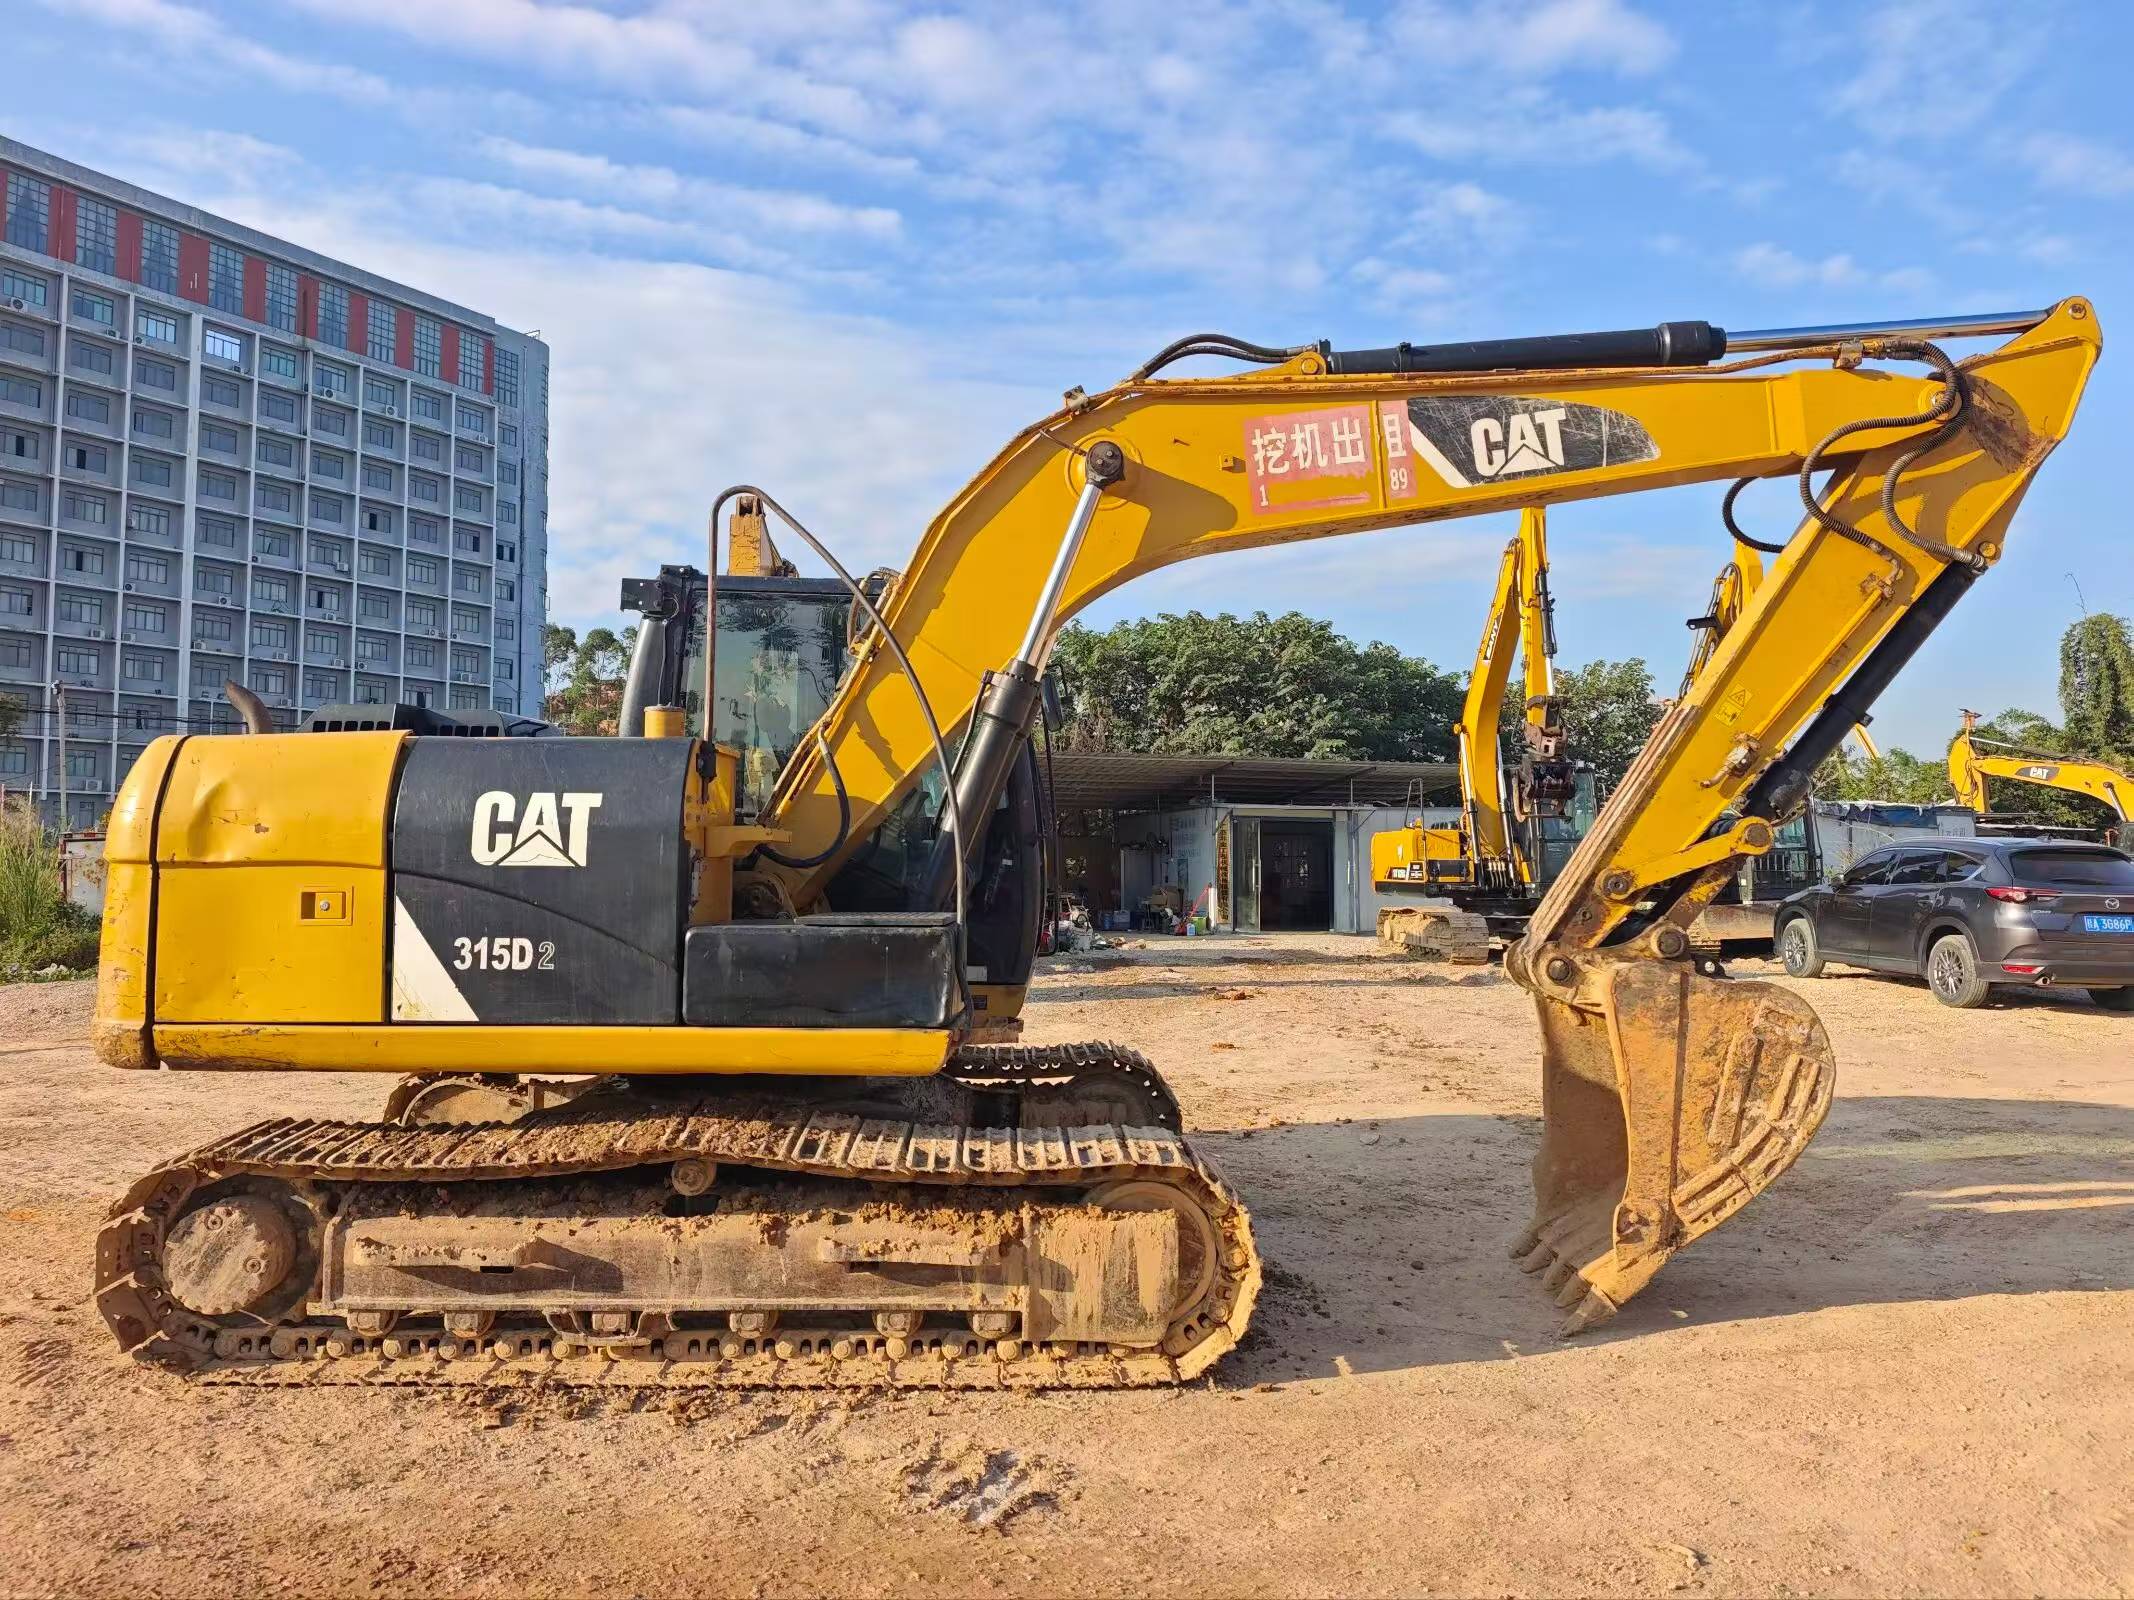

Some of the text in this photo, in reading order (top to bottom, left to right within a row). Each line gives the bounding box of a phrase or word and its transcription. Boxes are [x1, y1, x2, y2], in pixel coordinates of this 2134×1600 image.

[1470, 407, 1566, 477] CAT
[1390, 468, 1408, 491] 89
[2029, 766, 2049, 779] CAT
[470, 790, 603, 867] CAT
